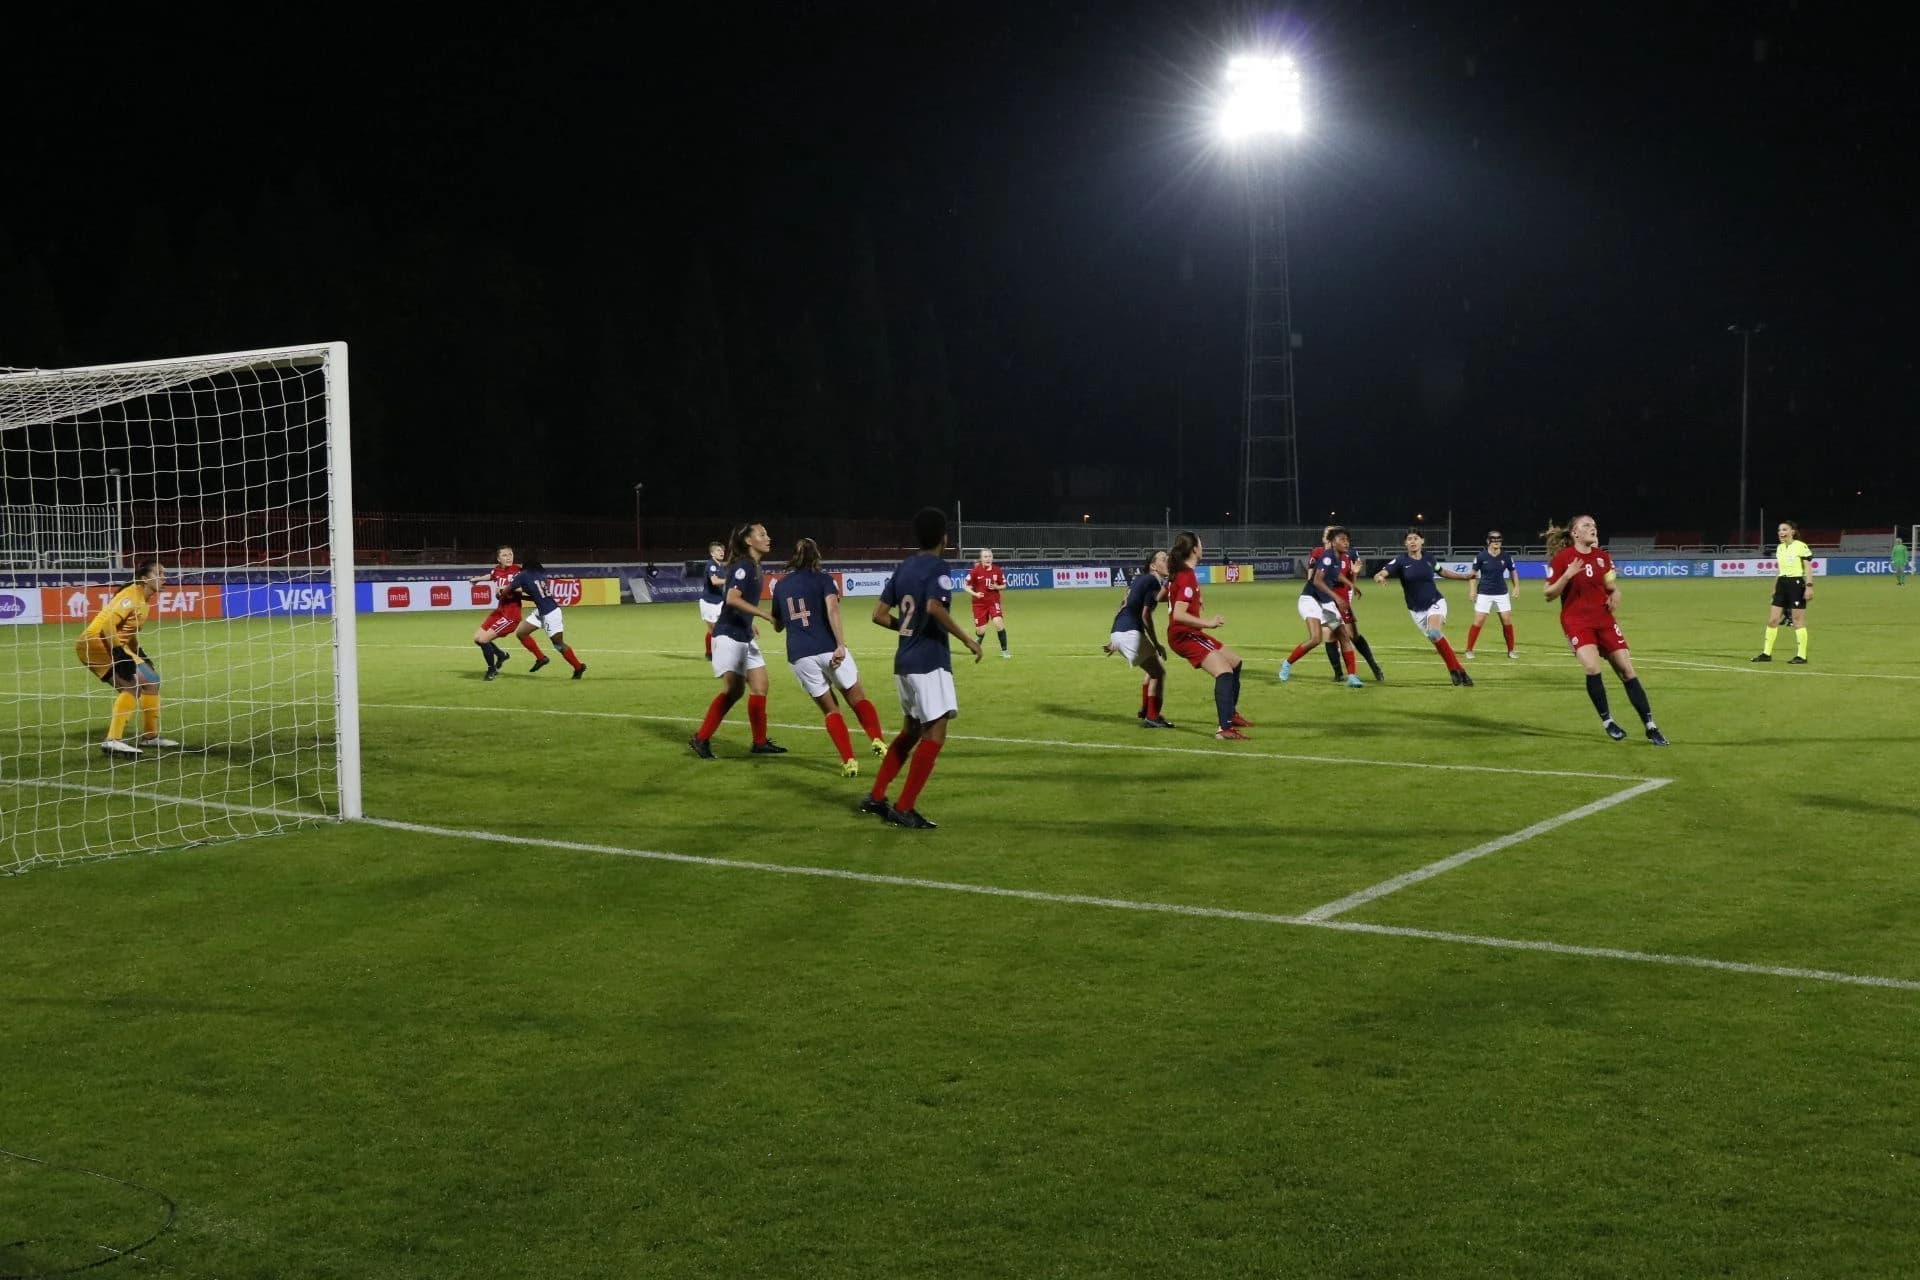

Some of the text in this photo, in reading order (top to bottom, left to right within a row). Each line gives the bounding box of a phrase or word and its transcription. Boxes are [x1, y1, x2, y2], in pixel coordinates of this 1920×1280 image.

[1006, 572, 1040, 587] GRIFOLS
[1584, 563, 1594, 577] 8
[1623, 563, 1689, 576] euronics
[157, 591, 200, 613] EAT
[275, 588, 327, 610] VISA
[786, 596, 811, 627] 4
[899, 594, 916, 637] 2
